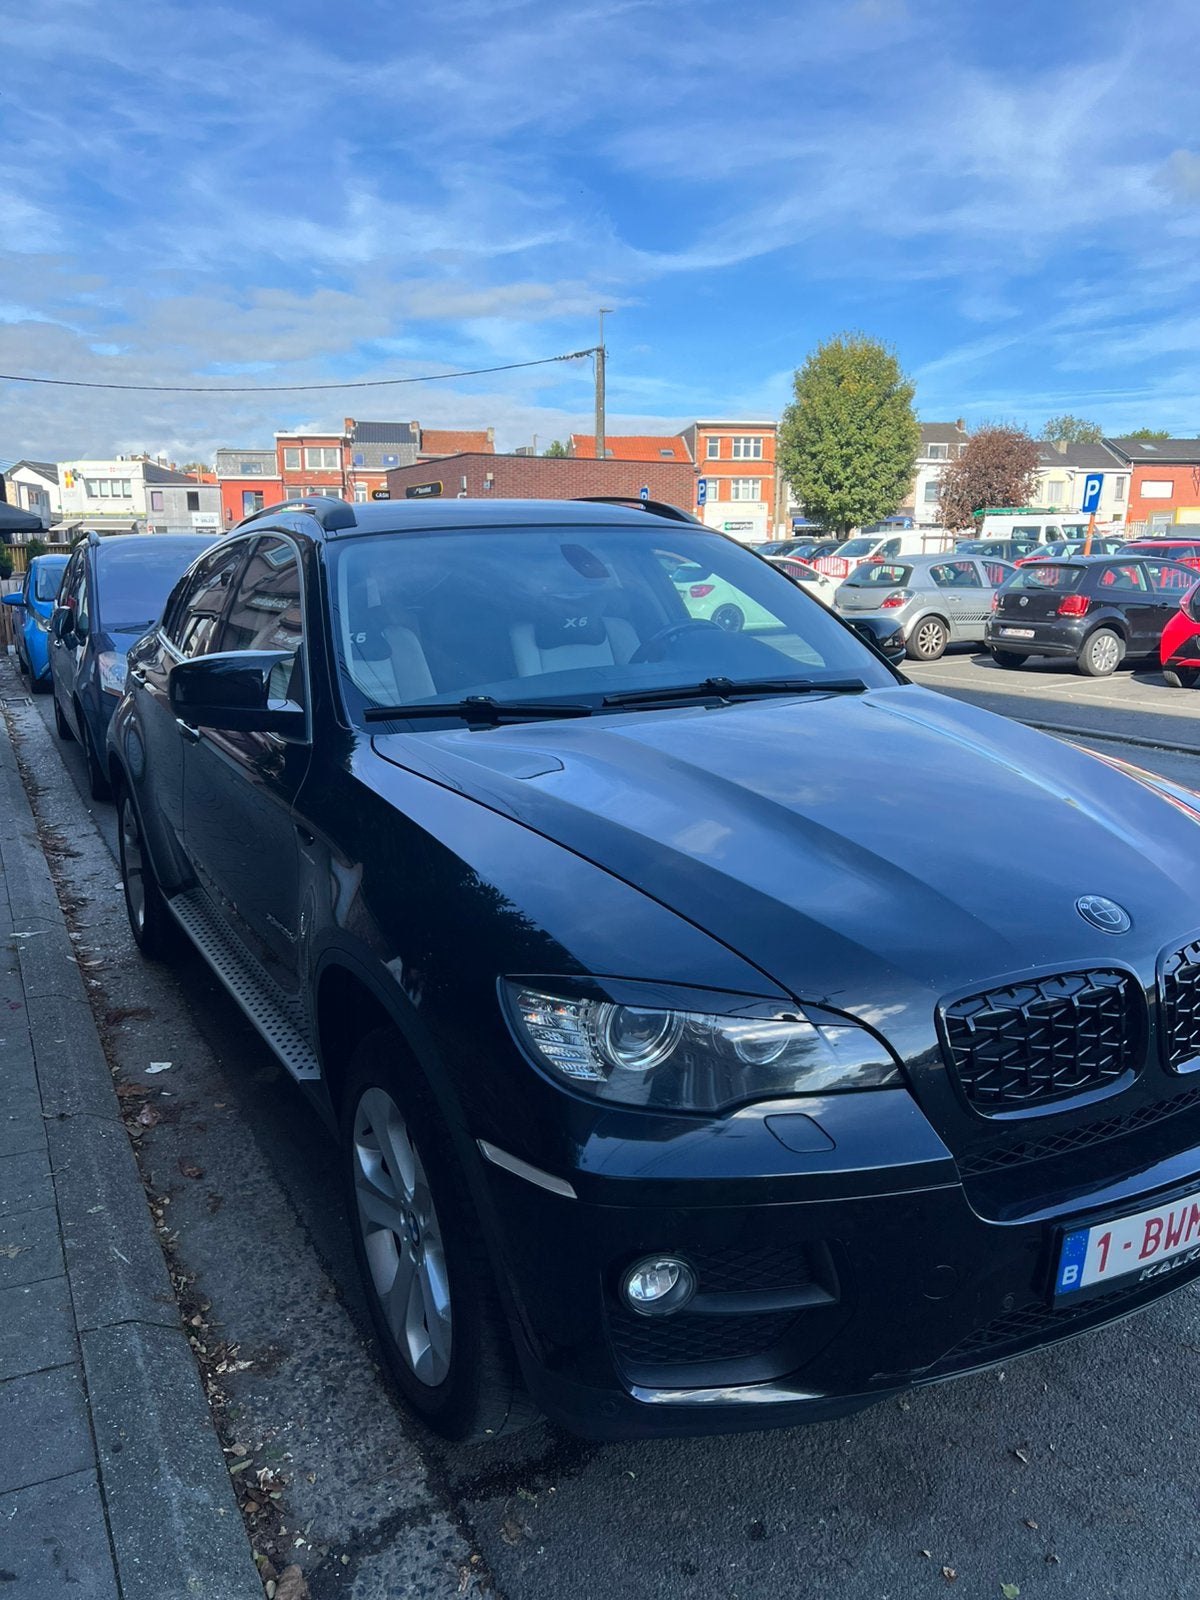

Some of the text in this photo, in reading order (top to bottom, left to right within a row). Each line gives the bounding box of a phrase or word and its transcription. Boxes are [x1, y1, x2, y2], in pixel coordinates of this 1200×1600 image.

[698, 483, 706, 501] P
[1084, 479, 1101, 508] P
[563, 616, 588, 628] X6
[1061, 1264, 1079, 1286] B
[1138, 1246, 1200, 1282] KALK
